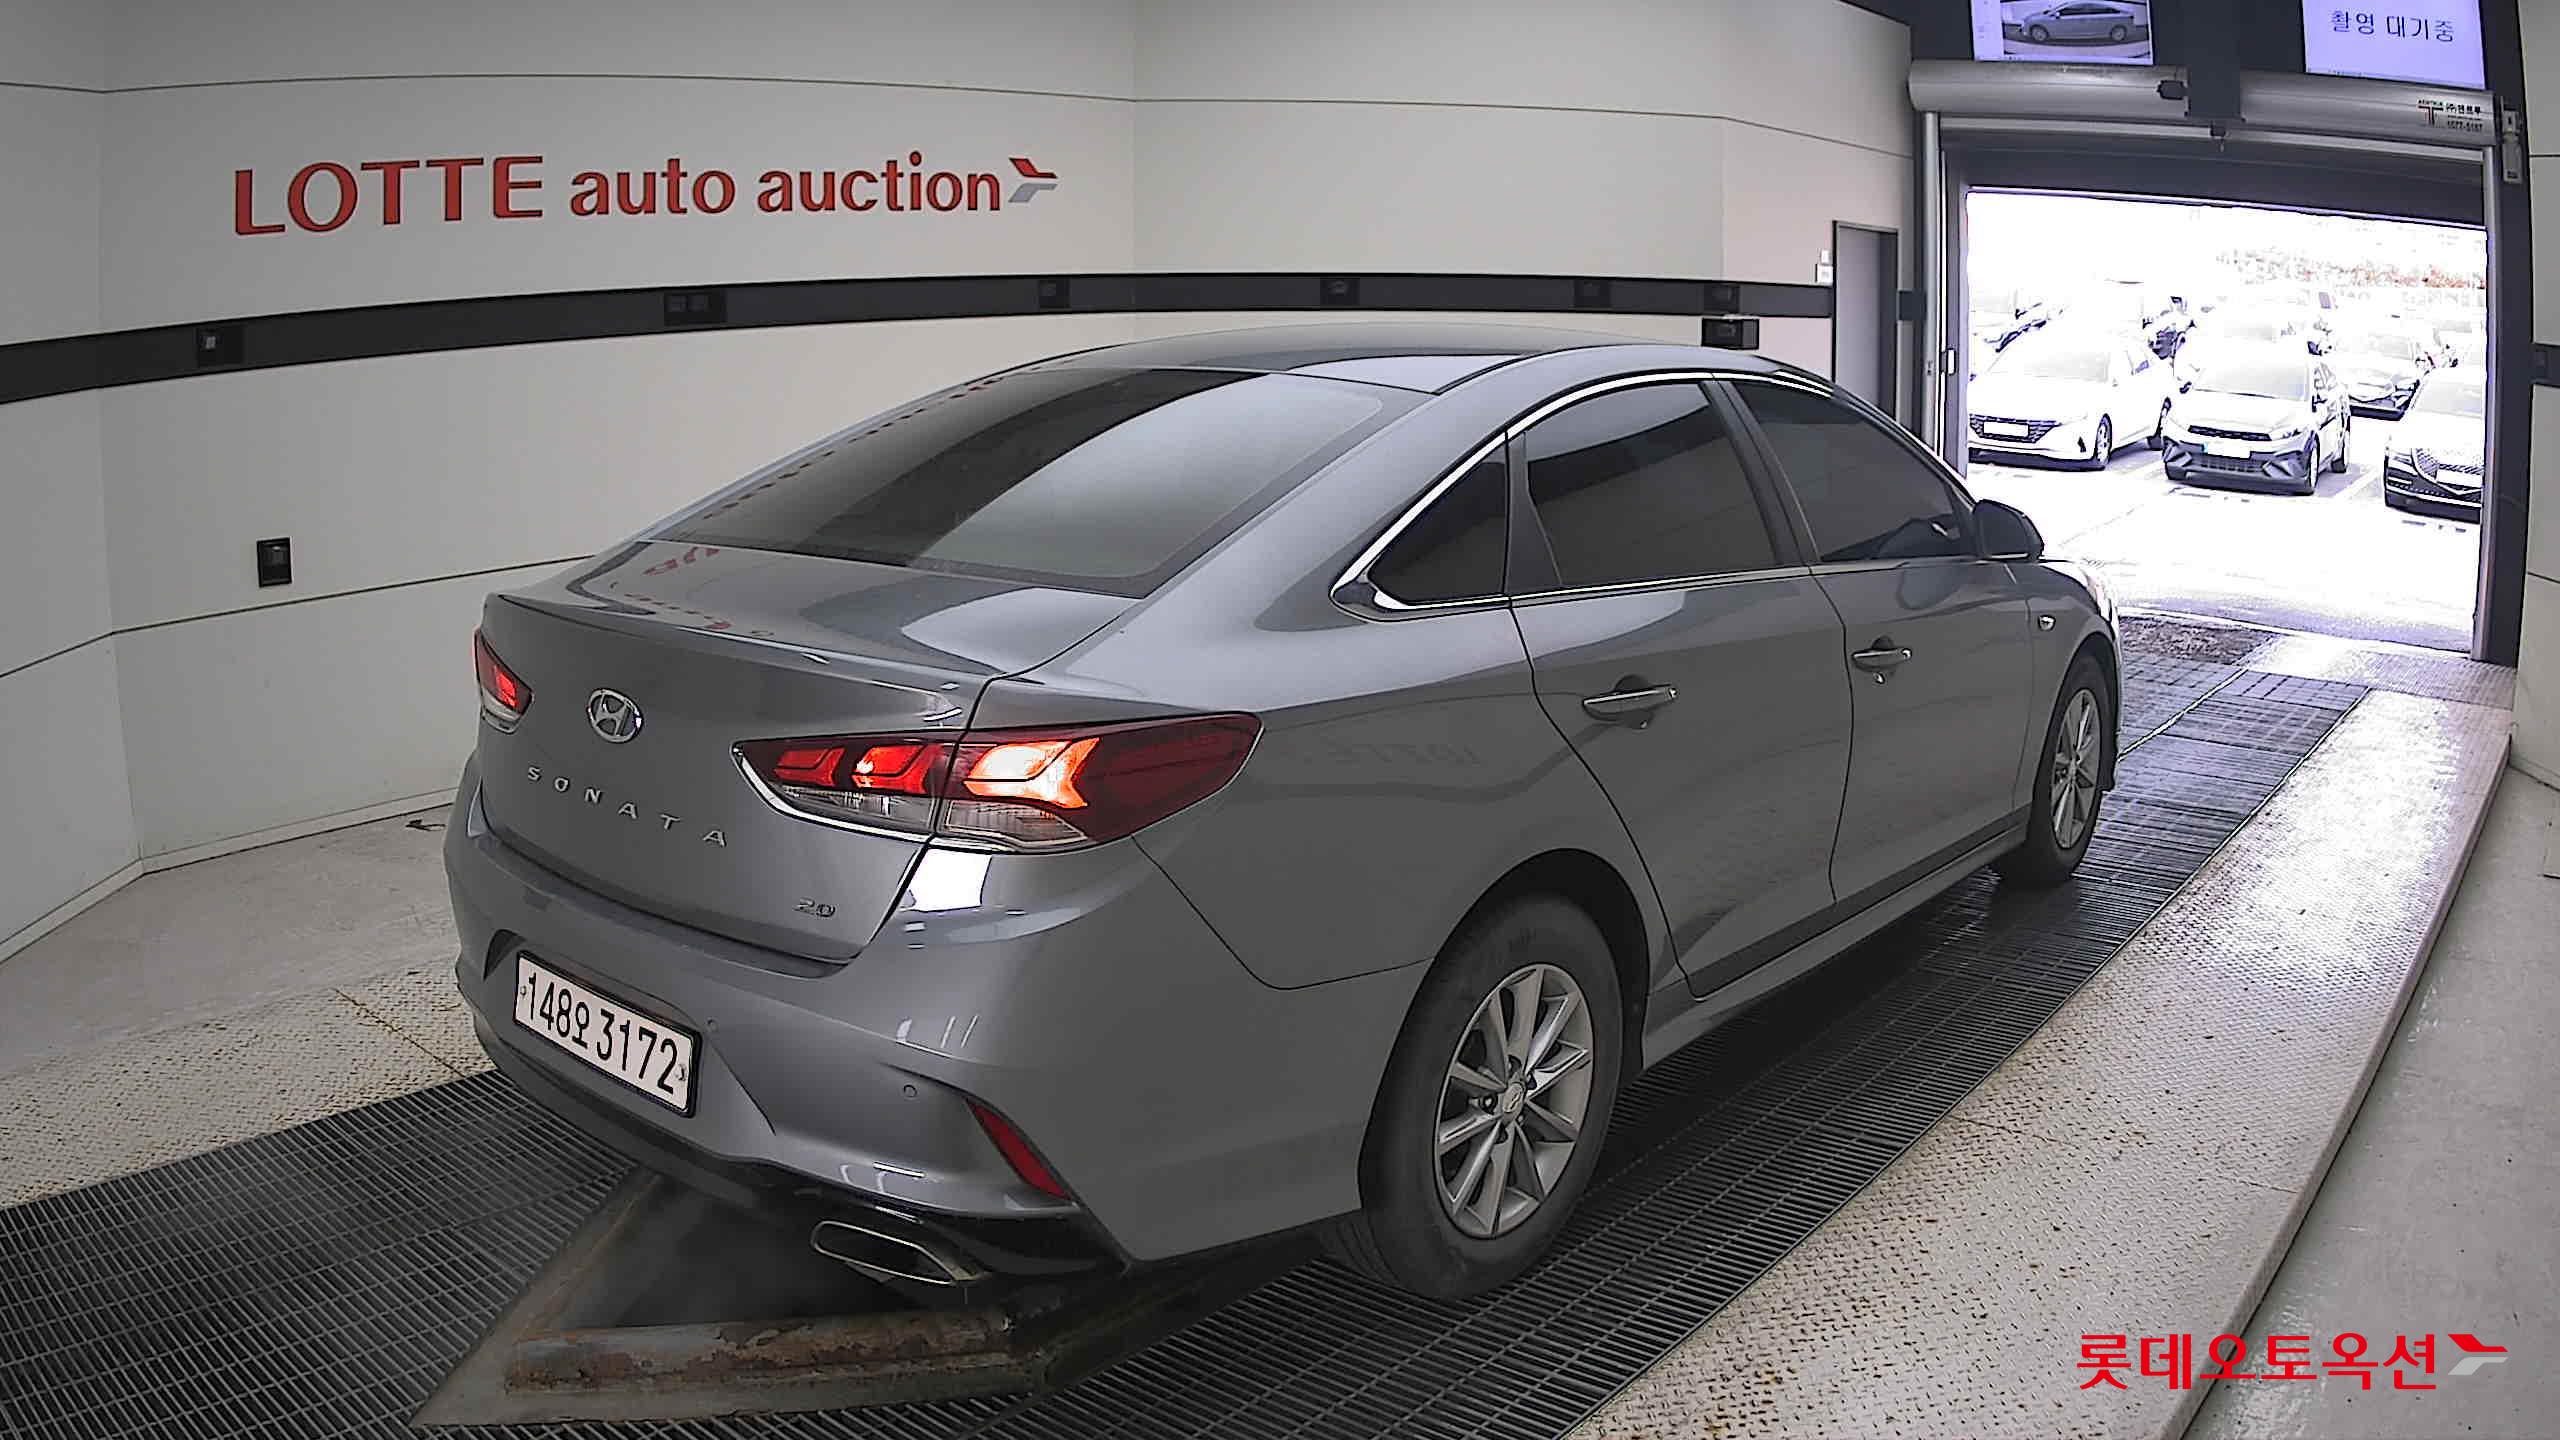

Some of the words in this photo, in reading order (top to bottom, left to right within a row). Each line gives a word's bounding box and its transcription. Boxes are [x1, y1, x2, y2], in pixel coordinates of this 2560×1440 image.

[2331, 10, 2375, 35] 촬영
[2386, 15, 2454, 42] 대기중
[235, 156, 544, 235] LOTTE
[570, 157, 736, 215] auto
[757, 150, 1001, 212] auction
[527, 766, 727, 848] SONATA
